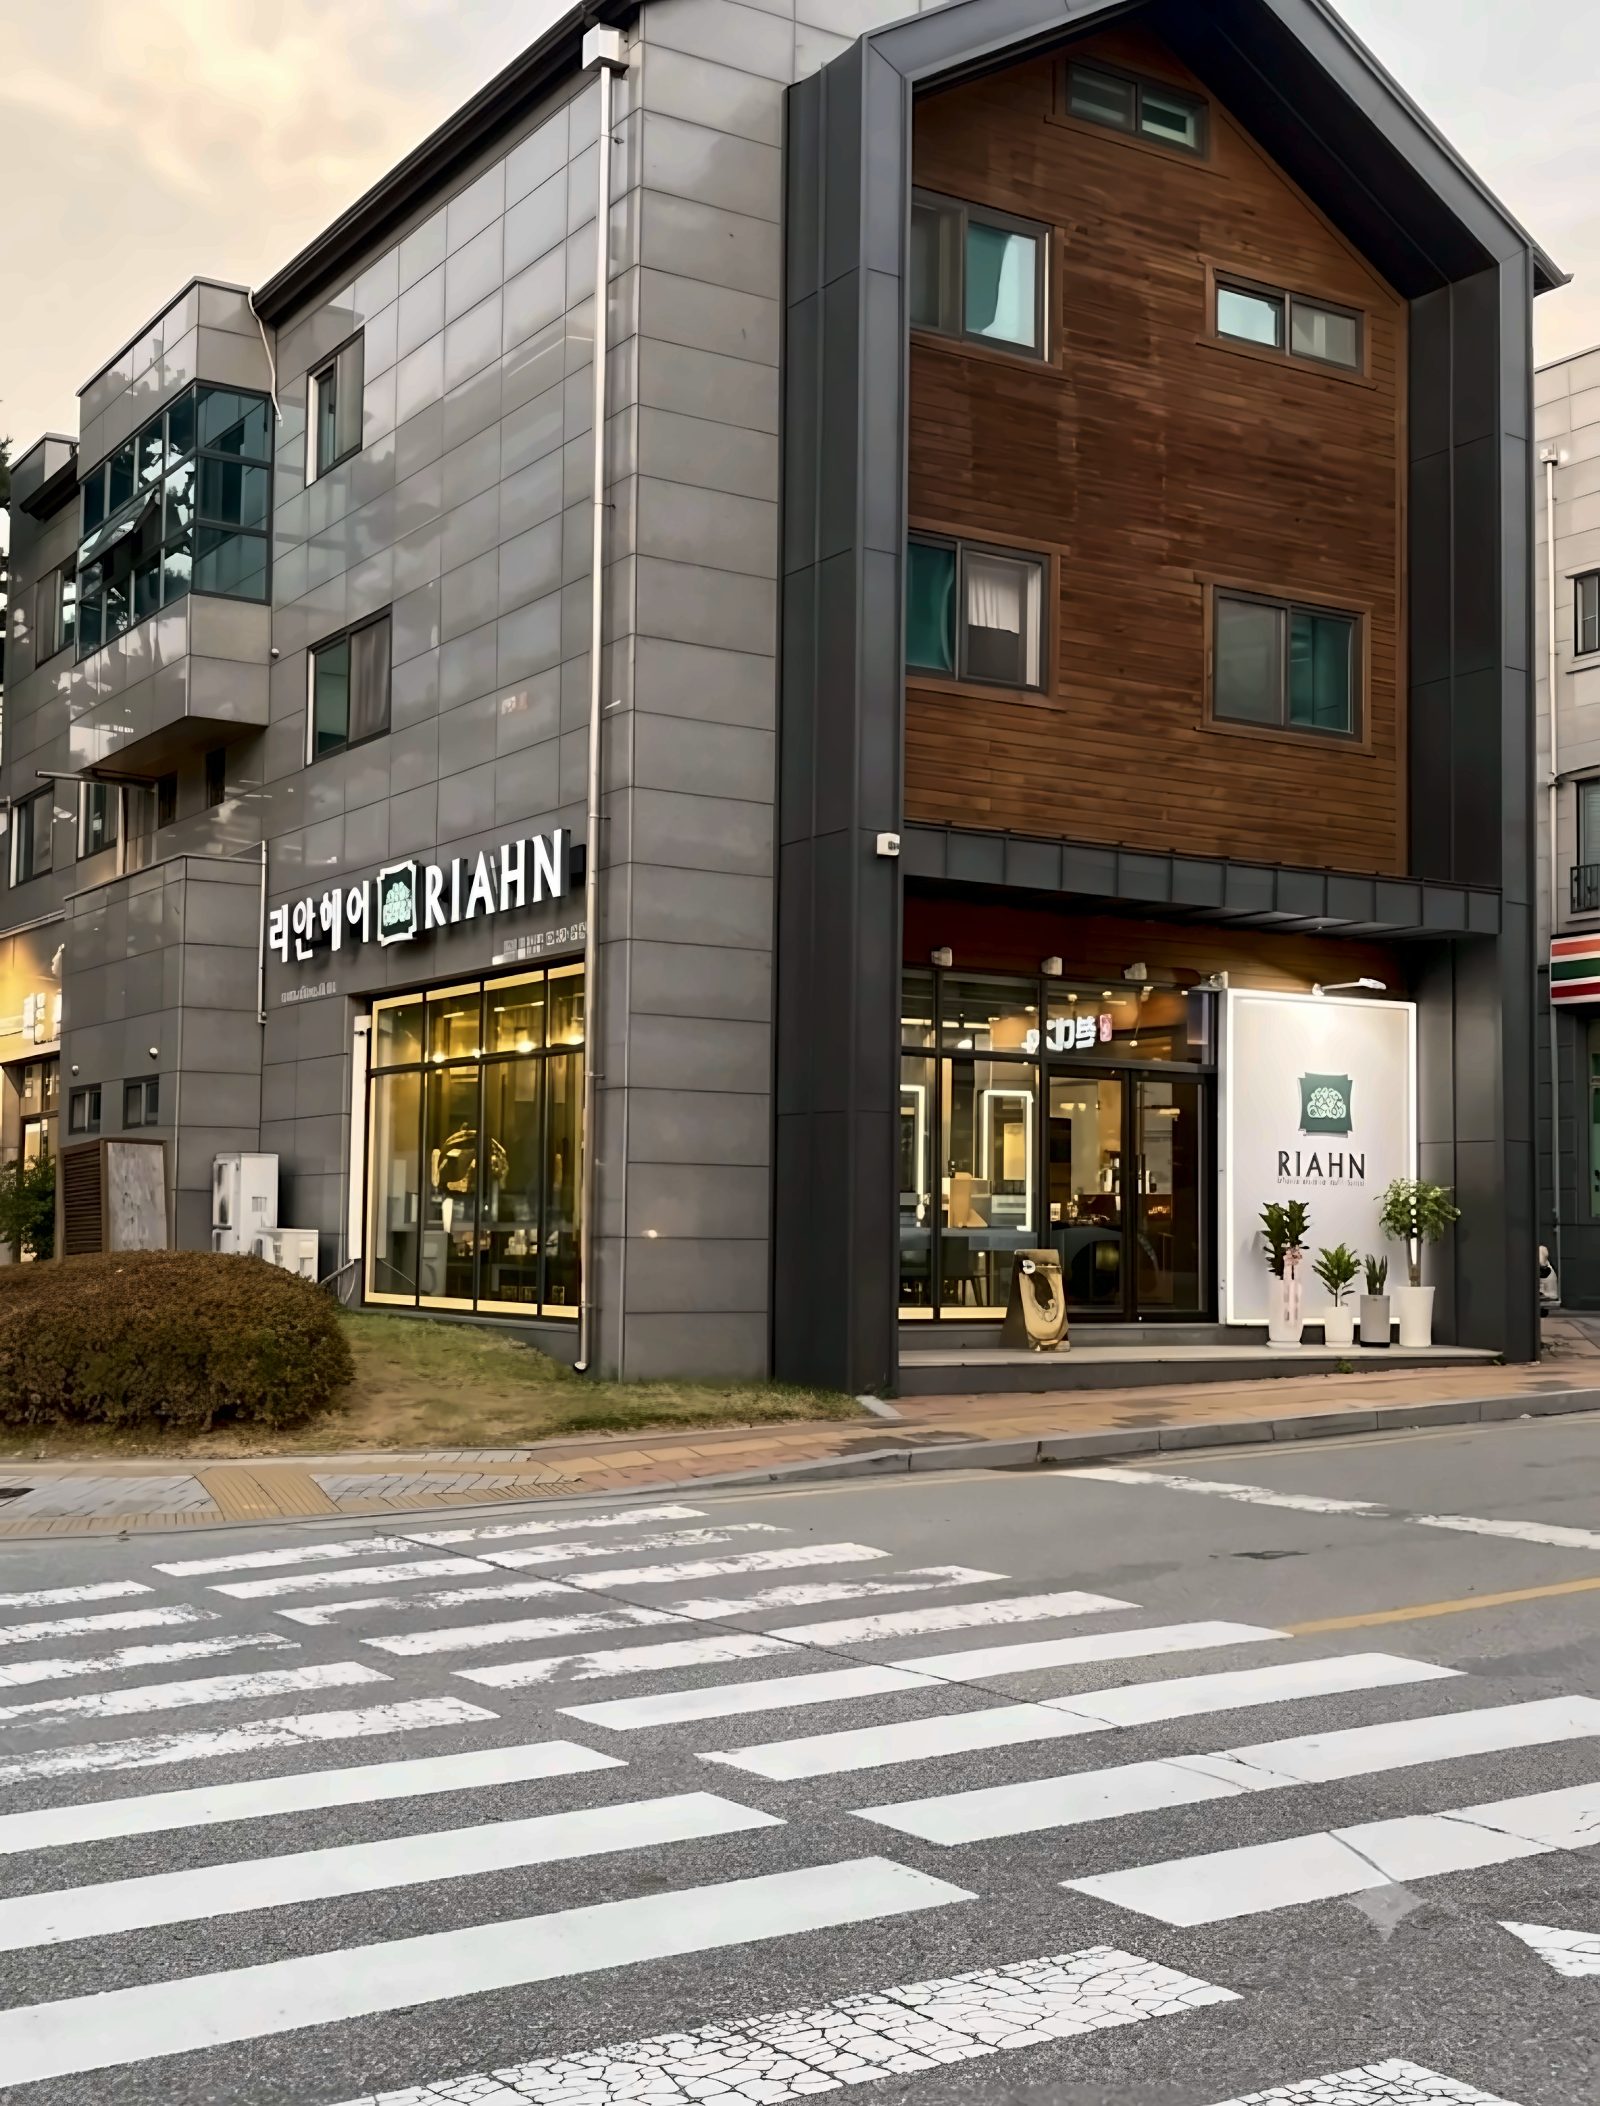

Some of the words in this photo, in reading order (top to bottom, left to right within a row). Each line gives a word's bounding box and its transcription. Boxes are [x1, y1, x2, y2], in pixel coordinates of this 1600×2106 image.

[269, 880, 370, 963] 리안헤어
[424, 828, 564, 930] RIAHN
[1277, 1150, 1366, 1179] RIAHN
